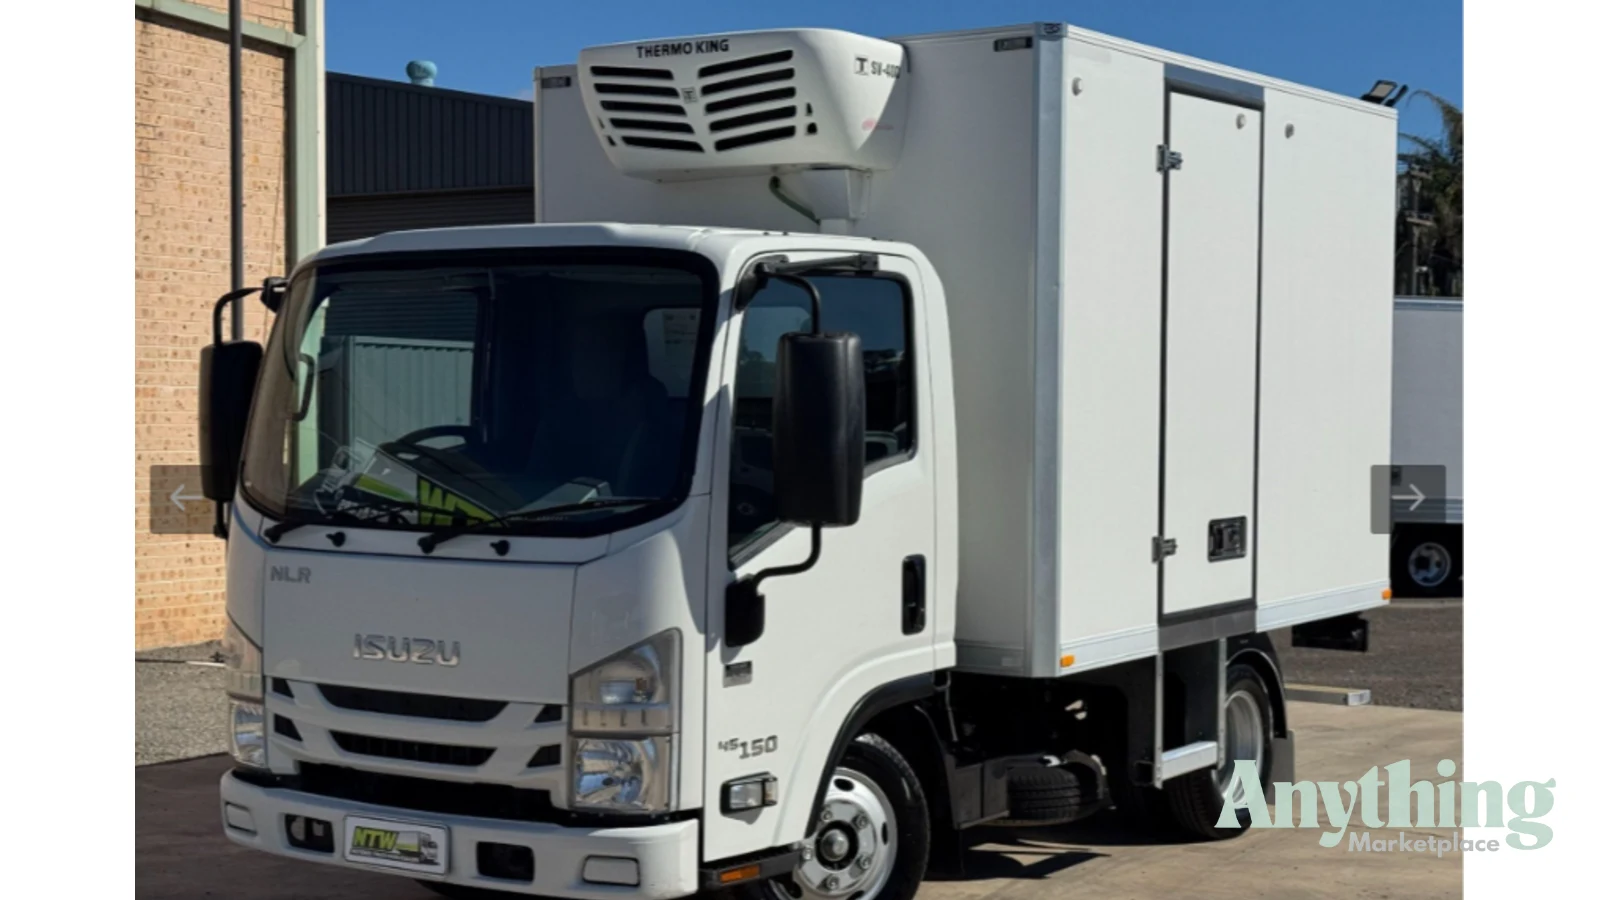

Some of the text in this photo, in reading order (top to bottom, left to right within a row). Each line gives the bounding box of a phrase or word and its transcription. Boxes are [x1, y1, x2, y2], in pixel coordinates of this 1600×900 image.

[636, 39, 729, 59] THERMO KING
[270, 565, 312, 583] NLR
[352, 633, 461, 666] ISUZU
[351, 826, 399, 852] NTW
